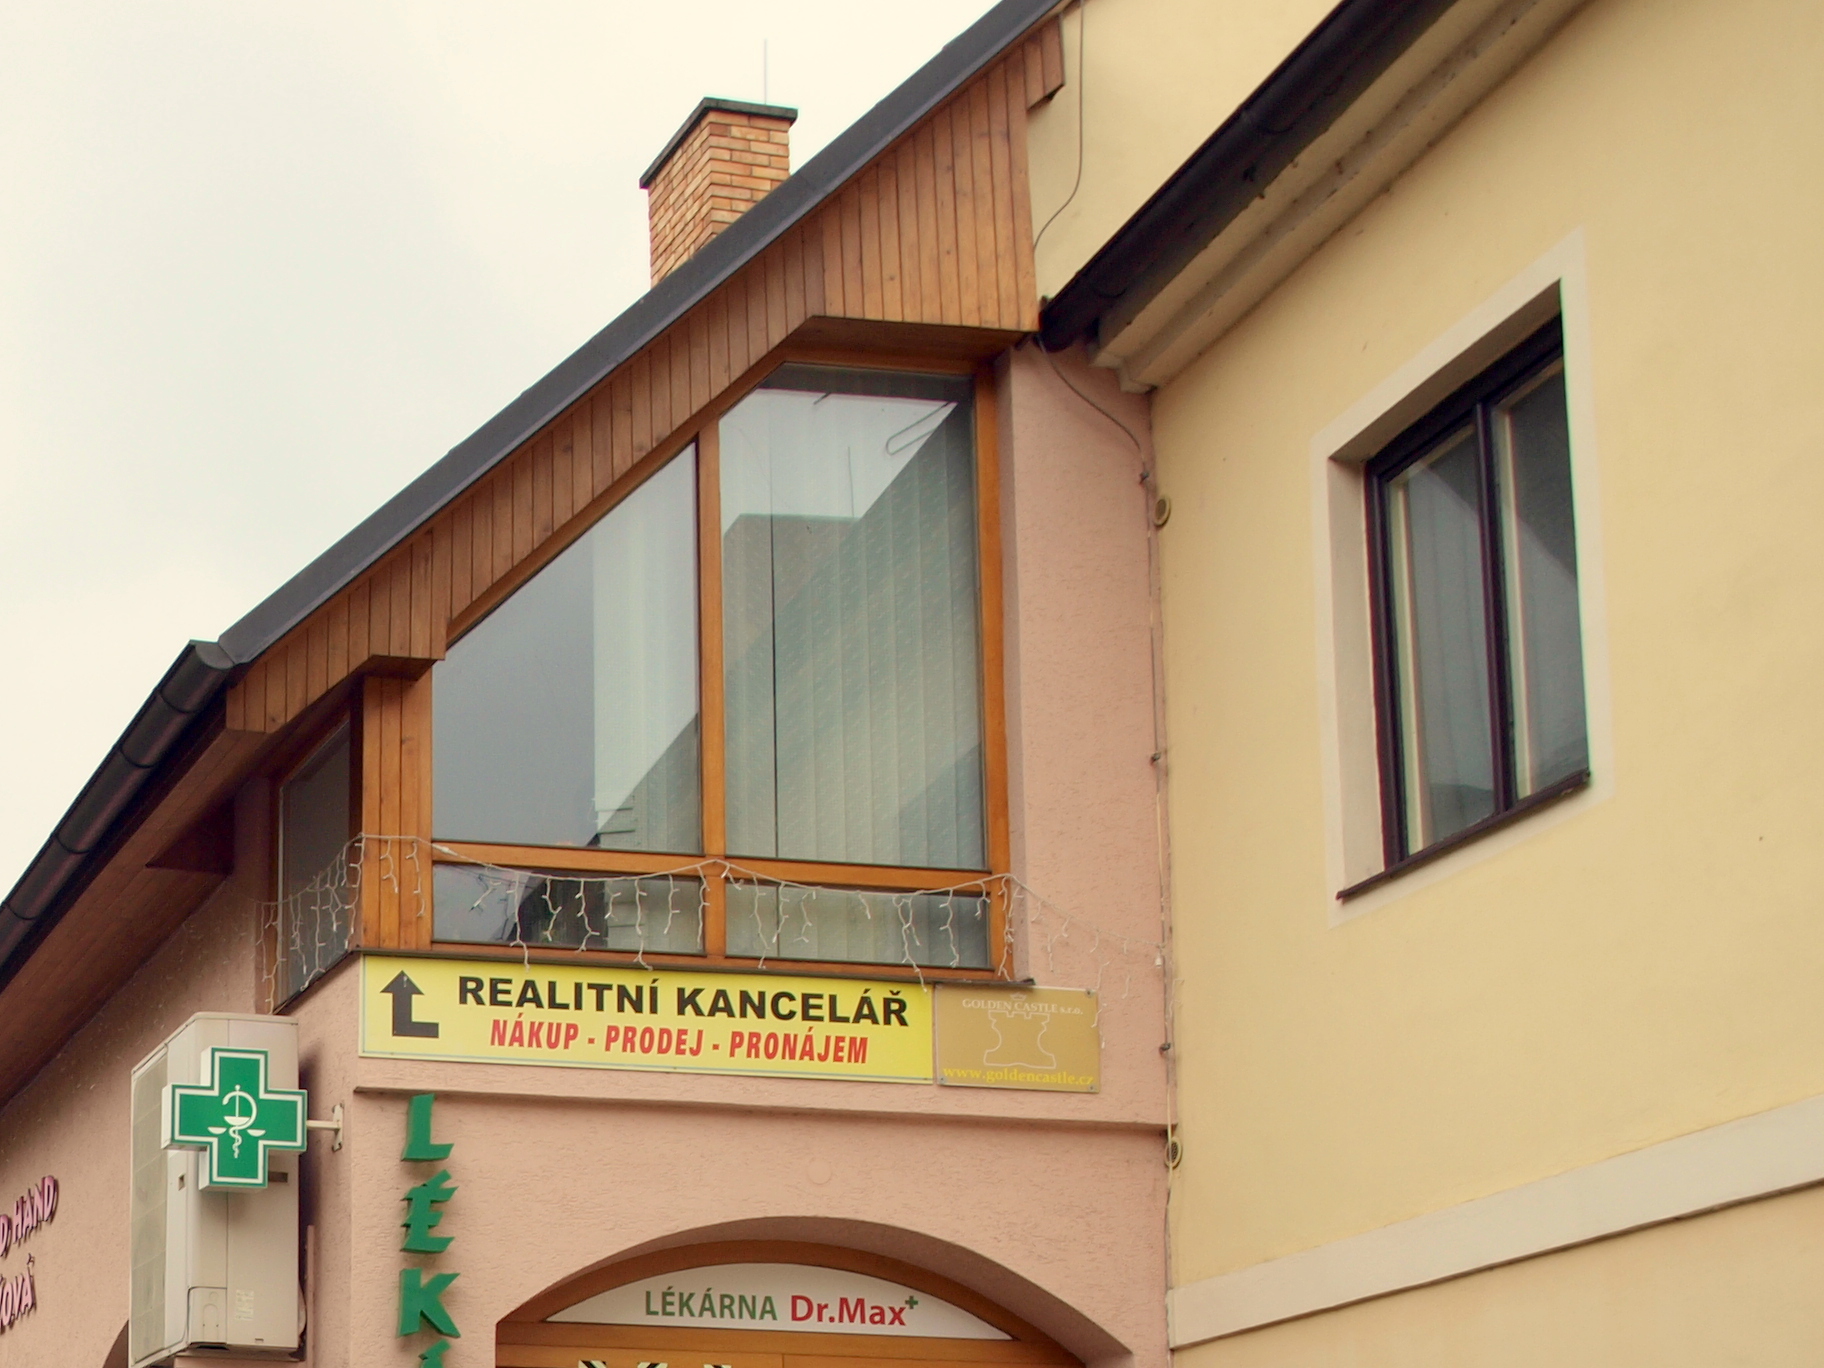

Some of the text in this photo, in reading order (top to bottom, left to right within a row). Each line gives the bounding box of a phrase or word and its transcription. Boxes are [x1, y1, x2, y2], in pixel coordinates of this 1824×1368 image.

[457, 973, 910, 1028] REALITNÍ KANCELÁŘ
[962, 999, 1012, 1011] GOLDEN
[1014, 1001, 1058, 1014] CASTLE
[489, 1016, 580, 1051] NÁKUP
[604, 1025, 704, 1058] PRODEJ
[728, 1028, 869, 1065] PRONÁJEM
[943, 1067, 1094, 1085] www.goldencastle.cz
[13, 1175, 59, 1246] HAND
[644, 1285, 778, 1321] LÉKÁRNA
